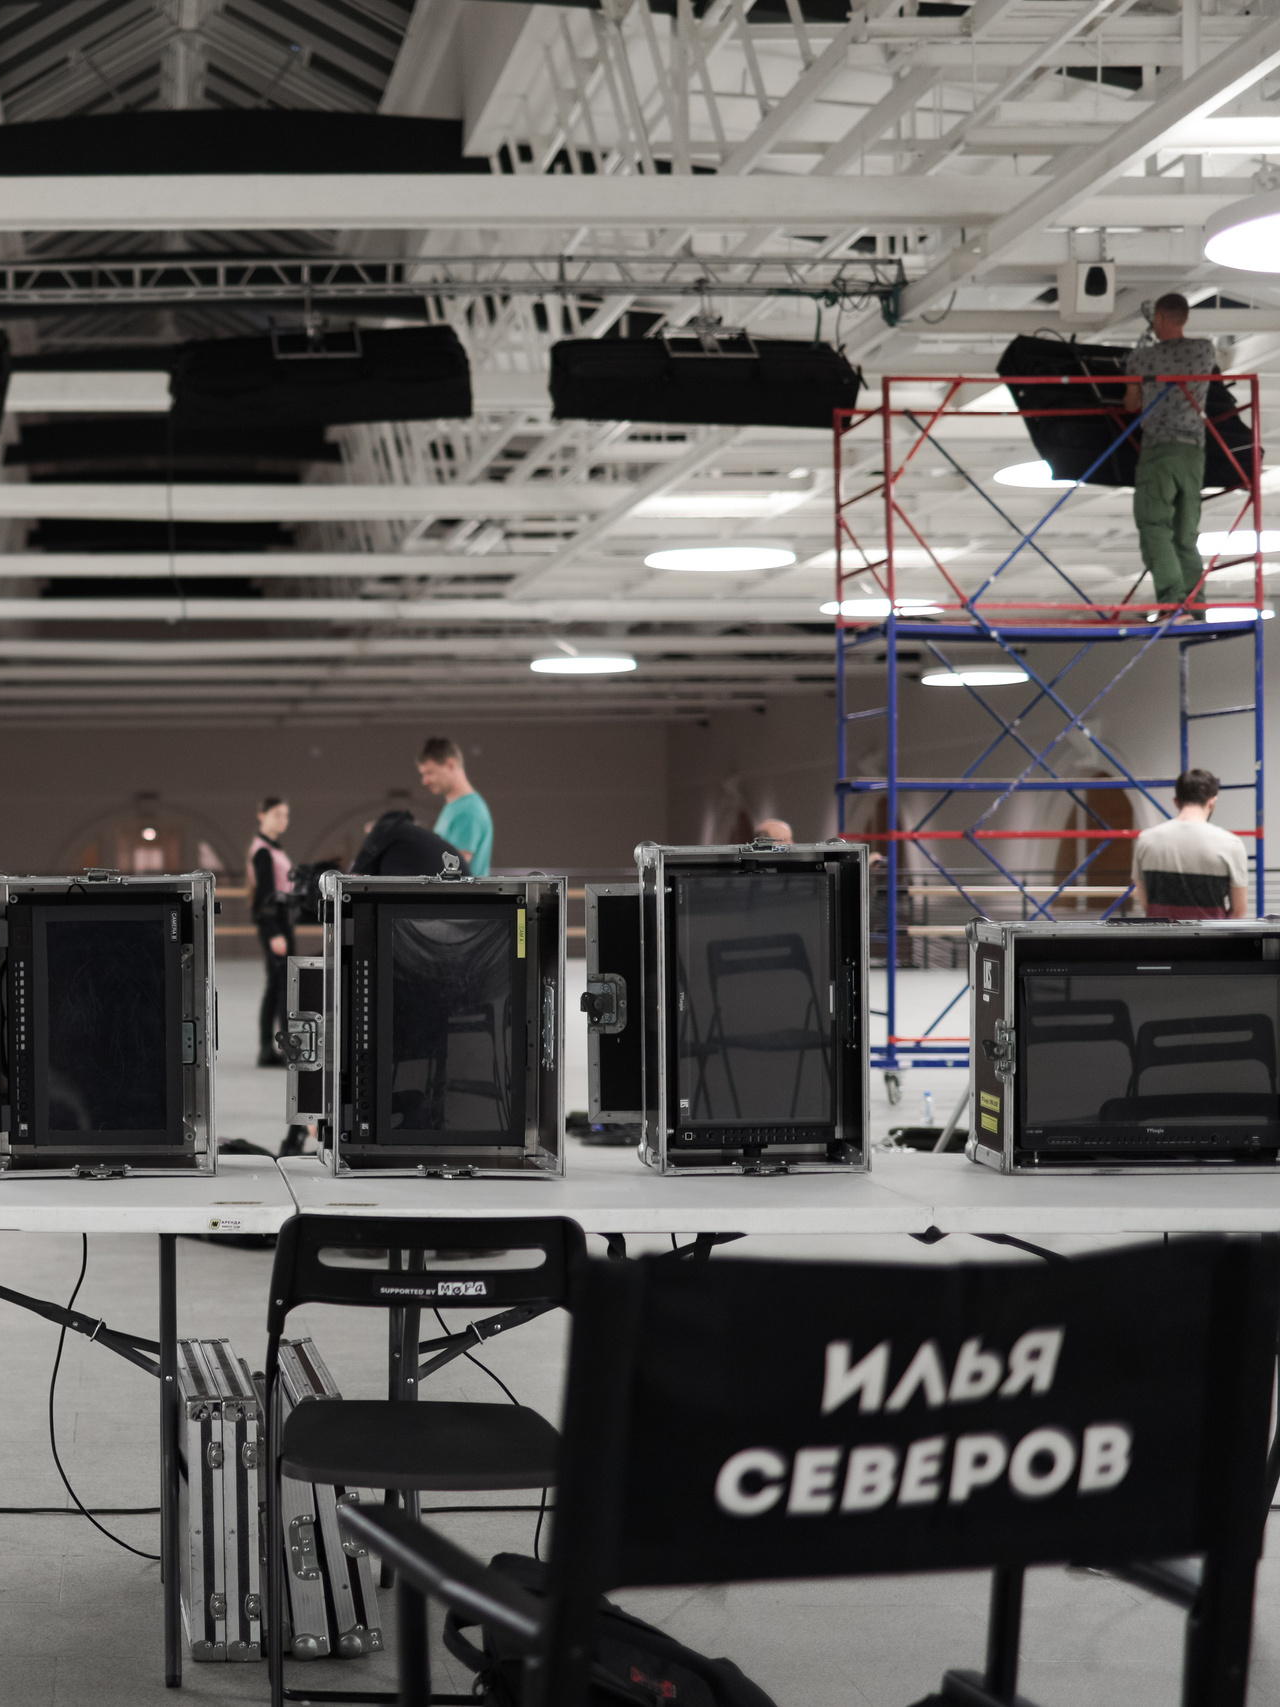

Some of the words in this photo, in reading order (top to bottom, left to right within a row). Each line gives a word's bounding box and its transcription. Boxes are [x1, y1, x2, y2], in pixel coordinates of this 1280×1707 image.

[380, 1287, 424, 1295] SUPPORTED
[819, 1325, 1066, 1416] ИЛЬЯ
[714, 1422, 1135, 1517] СЕВЕРОВ
